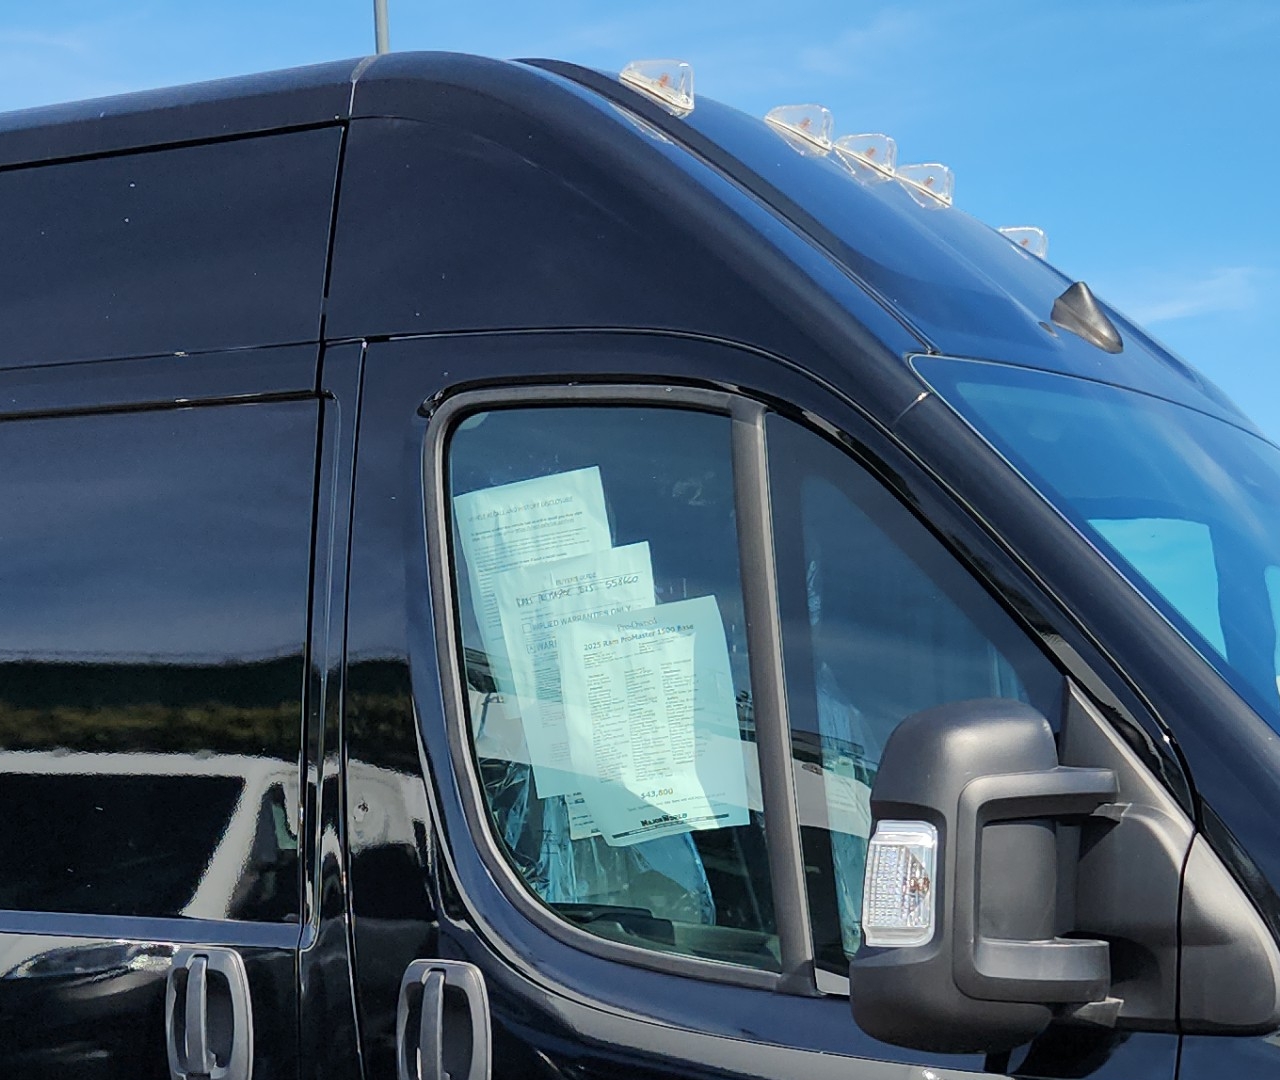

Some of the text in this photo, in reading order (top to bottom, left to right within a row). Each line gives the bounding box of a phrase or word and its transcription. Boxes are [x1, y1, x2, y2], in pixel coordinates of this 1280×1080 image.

[584, 641, 602, 651] 2025
[603, 639, 619, 648] Ram
[620, 631, 656, 644] ProMaster
